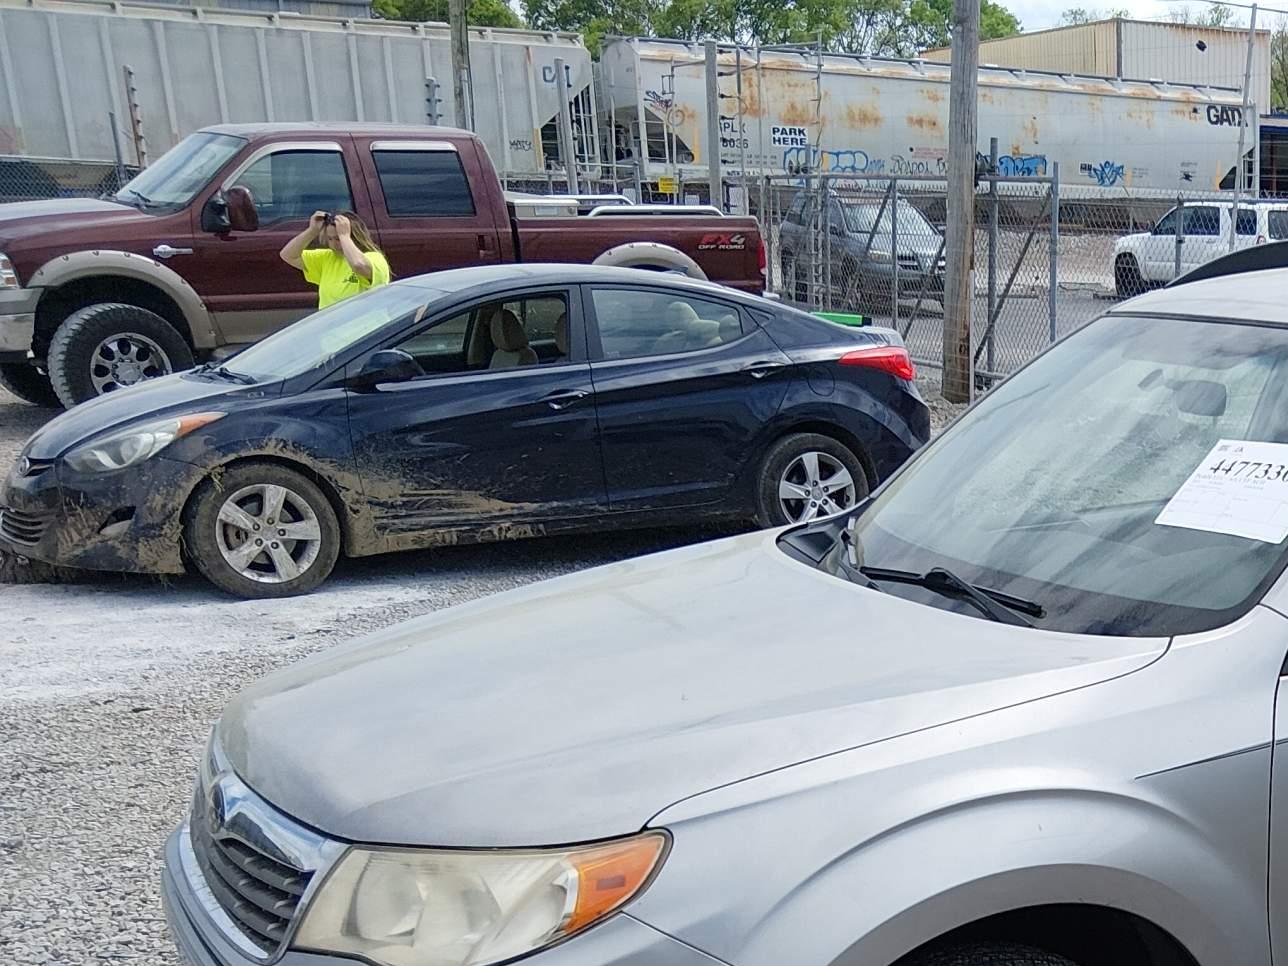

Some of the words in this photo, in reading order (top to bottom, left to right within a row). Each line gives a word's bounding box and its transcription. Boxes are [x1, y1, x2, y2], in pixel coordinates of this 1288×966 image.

[772, 127, 806, 137] PARK
[773, 136, 807, 146] HERE
[703, 234, 745, 245] FX4
